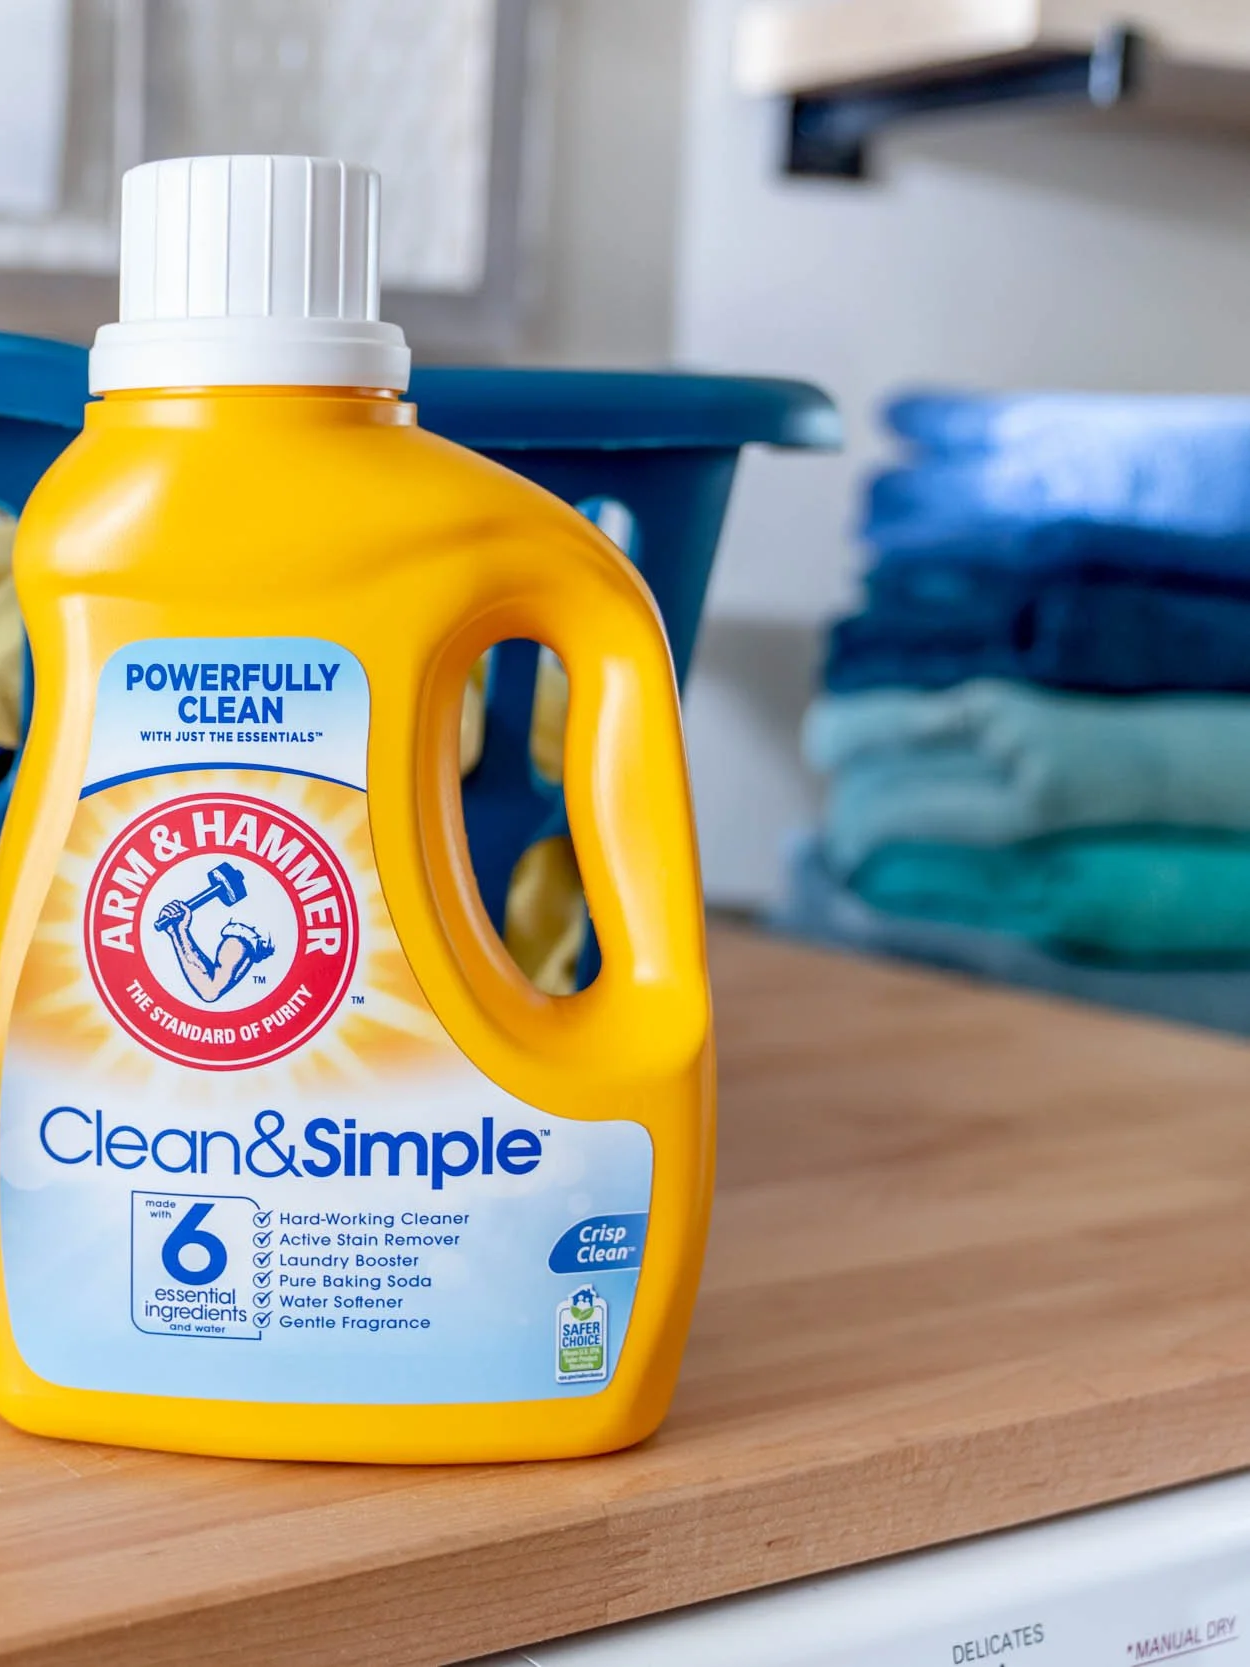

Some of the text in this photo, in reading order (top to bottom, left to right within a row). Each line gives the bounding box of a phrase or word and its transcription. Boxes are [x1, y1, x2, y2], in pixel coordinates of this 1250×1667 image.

[126, 663, 341, 691] POWERFULLY
[178, 695, 283, 724] CLEAN
[140, 731, 172, 742] WITH
[175, 731, 205, 742] JUST
[209, 731, 233, 742] THE
[101, 810, 342, 956] ARM & HAMMER
[125, 979, 313, 1044] THE STANDARD OF PURITY
[145, 1200, 176, 1208] made
[150, 1211, 172, 1219] with
[279, 1212, 469, 1228] Hard-Working Cleaner
[279, 1233, 461, 1246] Active Stain Remover
[579, 1223, 626, 1243] Crisp
[161, 1203, 228, 1286] 6
[279, 1253, 419, 1269] Laundry Booster
[279, 1274, 432, 1290] Pure Baking Soda
[154, 1288, 236, 1305] essential
[279, 1294, 404, 1309] Water Softener
[145, 1300, 248, 1322] ingredients
[169, 1323, 226, 1334] and water
[279, 1315, 431, 1331] Gentle Fragrance
[562, 1322, 600, 1336] SAFER
[562, 1334, 600, 1347] CHOICE
[1206, 1616, 1237, 1640] DRY
[952, 1623, 1044, 1664] DELICATES
